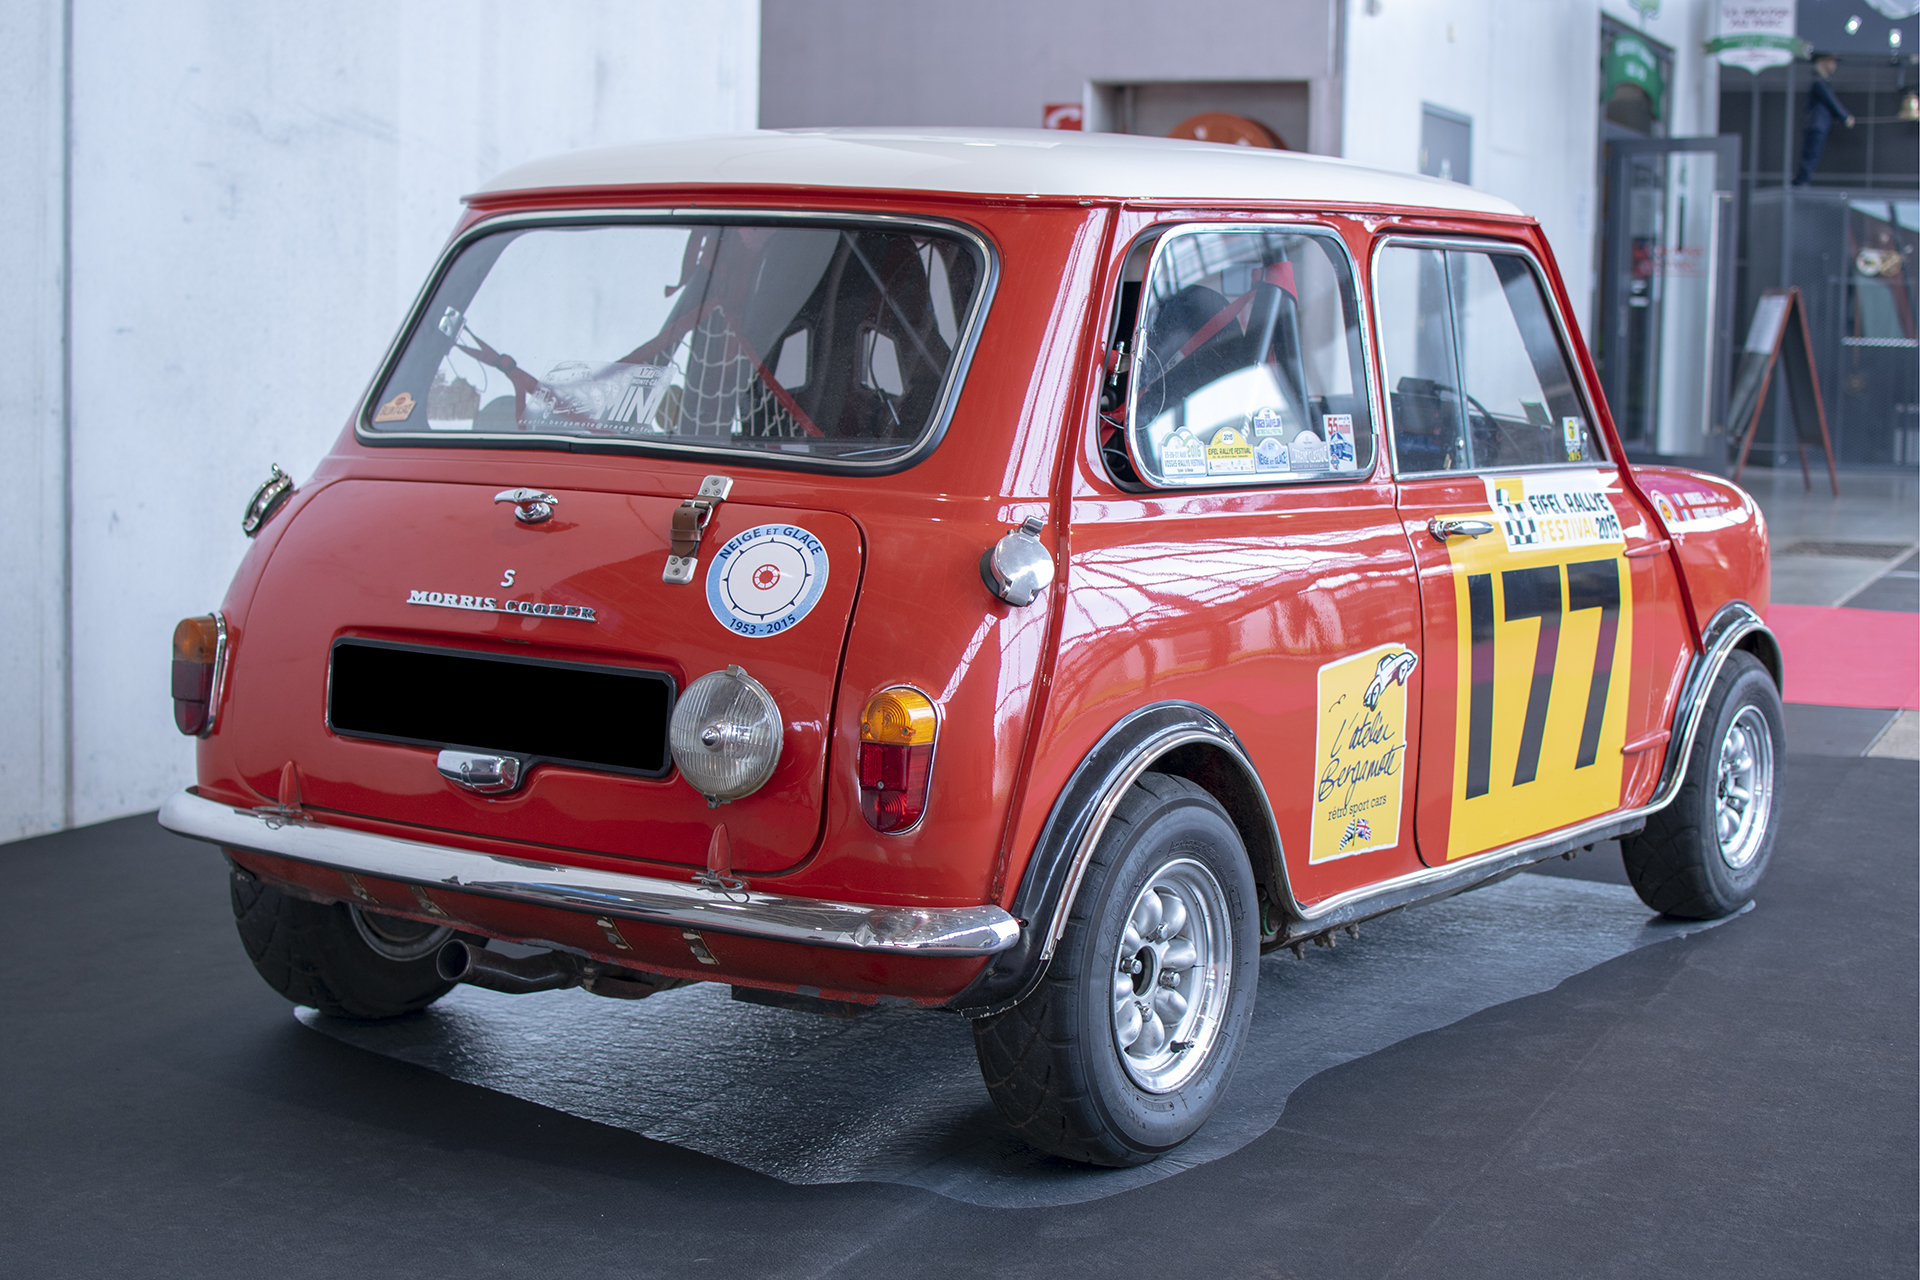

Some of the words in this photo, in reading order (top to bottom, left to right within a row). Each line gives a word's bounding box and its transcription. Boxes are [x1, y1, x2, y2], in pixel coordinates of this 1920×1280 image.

[1528, 493, 1567, 515] EIFEL
[1563, 492, 1609, 513] RALLYE
[1538, 517, 1598, 542] FESTIVAL
[1595, 514, 1620, 539] 2015
[719, 528, 762, 560] NEIGE
[766, 527, 779, 536] ET
[783, 527, 823, 556] GLACE
[500, 569, 516, 588] S
[408, 590, 497, 610] MORRIS
[505, 600, 596, 620] COOPER
[729, 618, 757, 635] 1953
[766, 614, 796, 634] 2015
[1465, 558, 1621, 801] 177
[1318, 744, 1406, 809] Bergamote
[1328, 805, 1348, 821] rétro
[1350, 798, 1370, 817] sport
[1371, 794, 1387, 808] cars
